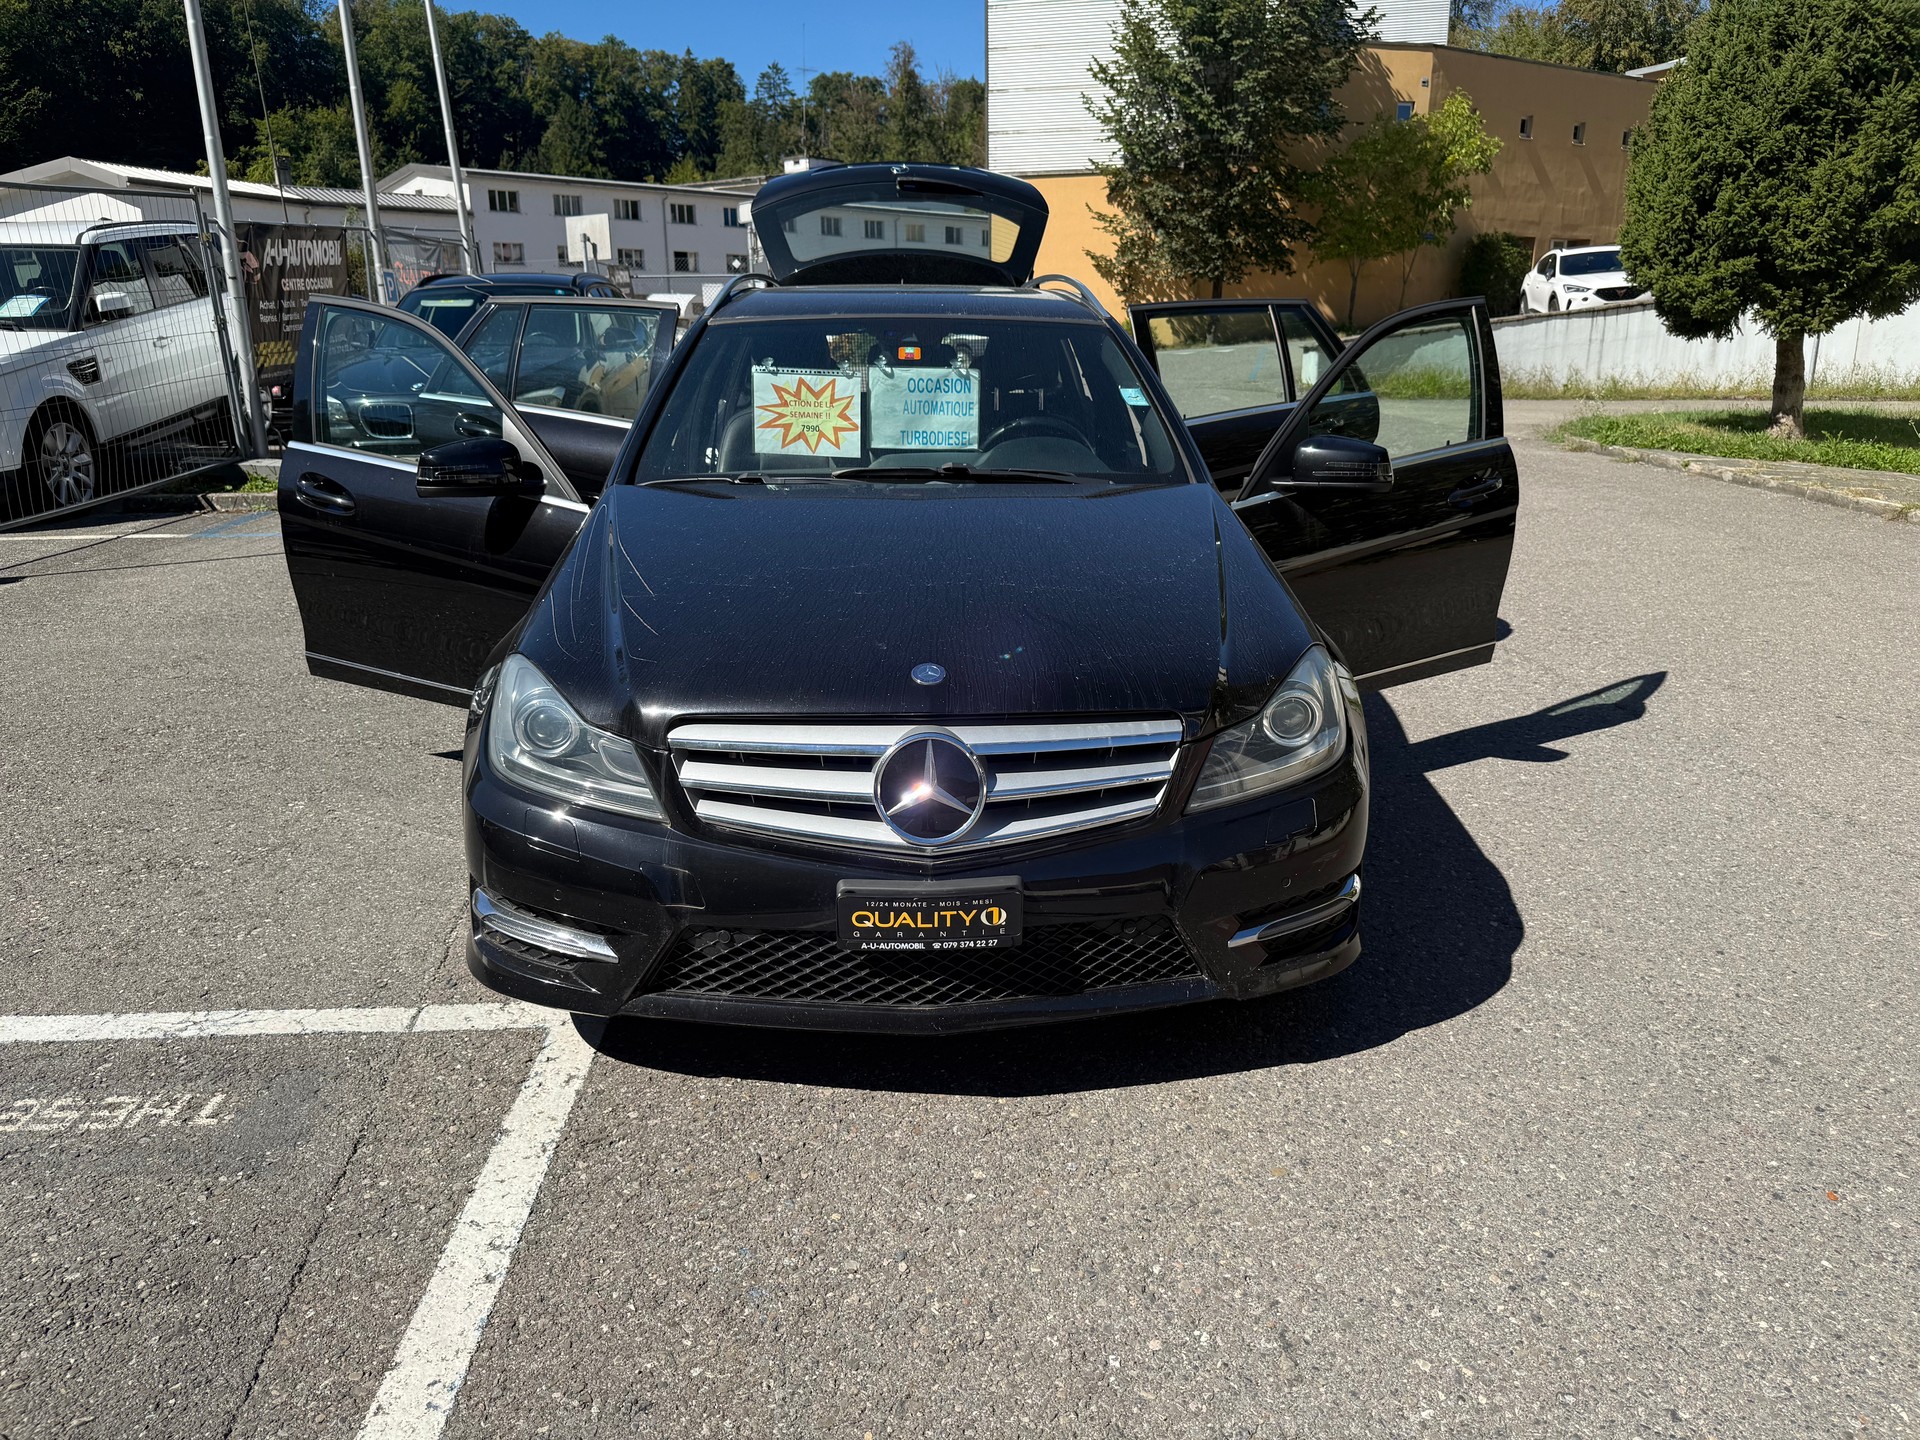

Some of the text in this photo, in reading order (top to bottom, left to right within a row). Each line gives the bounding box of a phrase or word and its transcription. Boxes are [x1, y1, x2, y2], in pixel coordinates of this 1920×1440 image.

[281, 277, 334, 291] CENTRE OCCASION
[386, 276, 394, 298] P
[259, 300, 276, 310] Achat
[907, 377, 972, 394] OCCASION
[784, 400, 812, 408] ACTION
[902, 400, 975, 418] AUTOMATIQUE
[789, 411, 824, 419] SEMAINE
[801, 425, 821, 433] 7990
[900, 430, 973, 446] TURBODIESEL
[851, 909, 978, 928] QUALITY
[860, 942, 926, 950] A-U-AUTOMOBIL
[942, 941, 958, 949] 079
[959, 940, 975, 948] 374
[988, 939, 998, 947] 27
